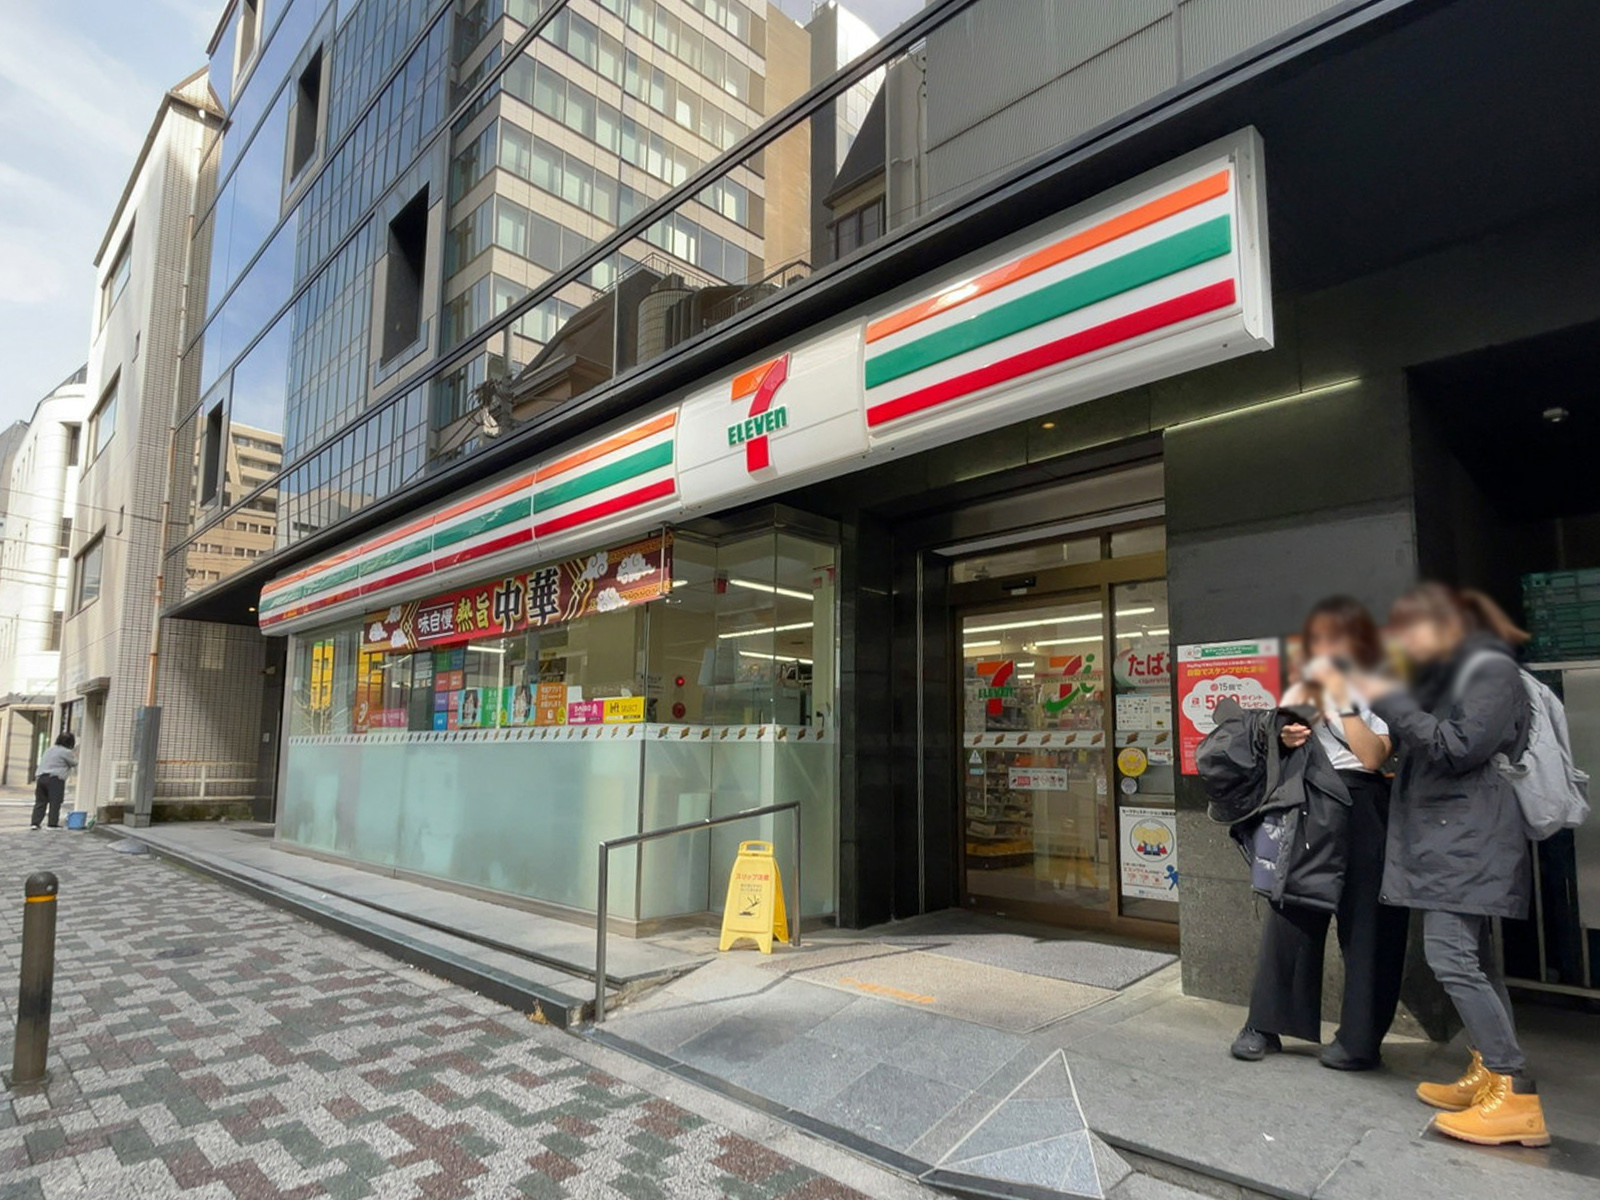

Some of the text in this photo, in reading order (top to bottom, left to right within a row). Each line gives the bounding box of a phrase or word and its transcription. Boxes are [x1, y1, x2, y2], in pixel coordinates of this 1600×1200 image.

[731, 351, 789, 473] 7
[418, 606, 454, 635] 味自慢
